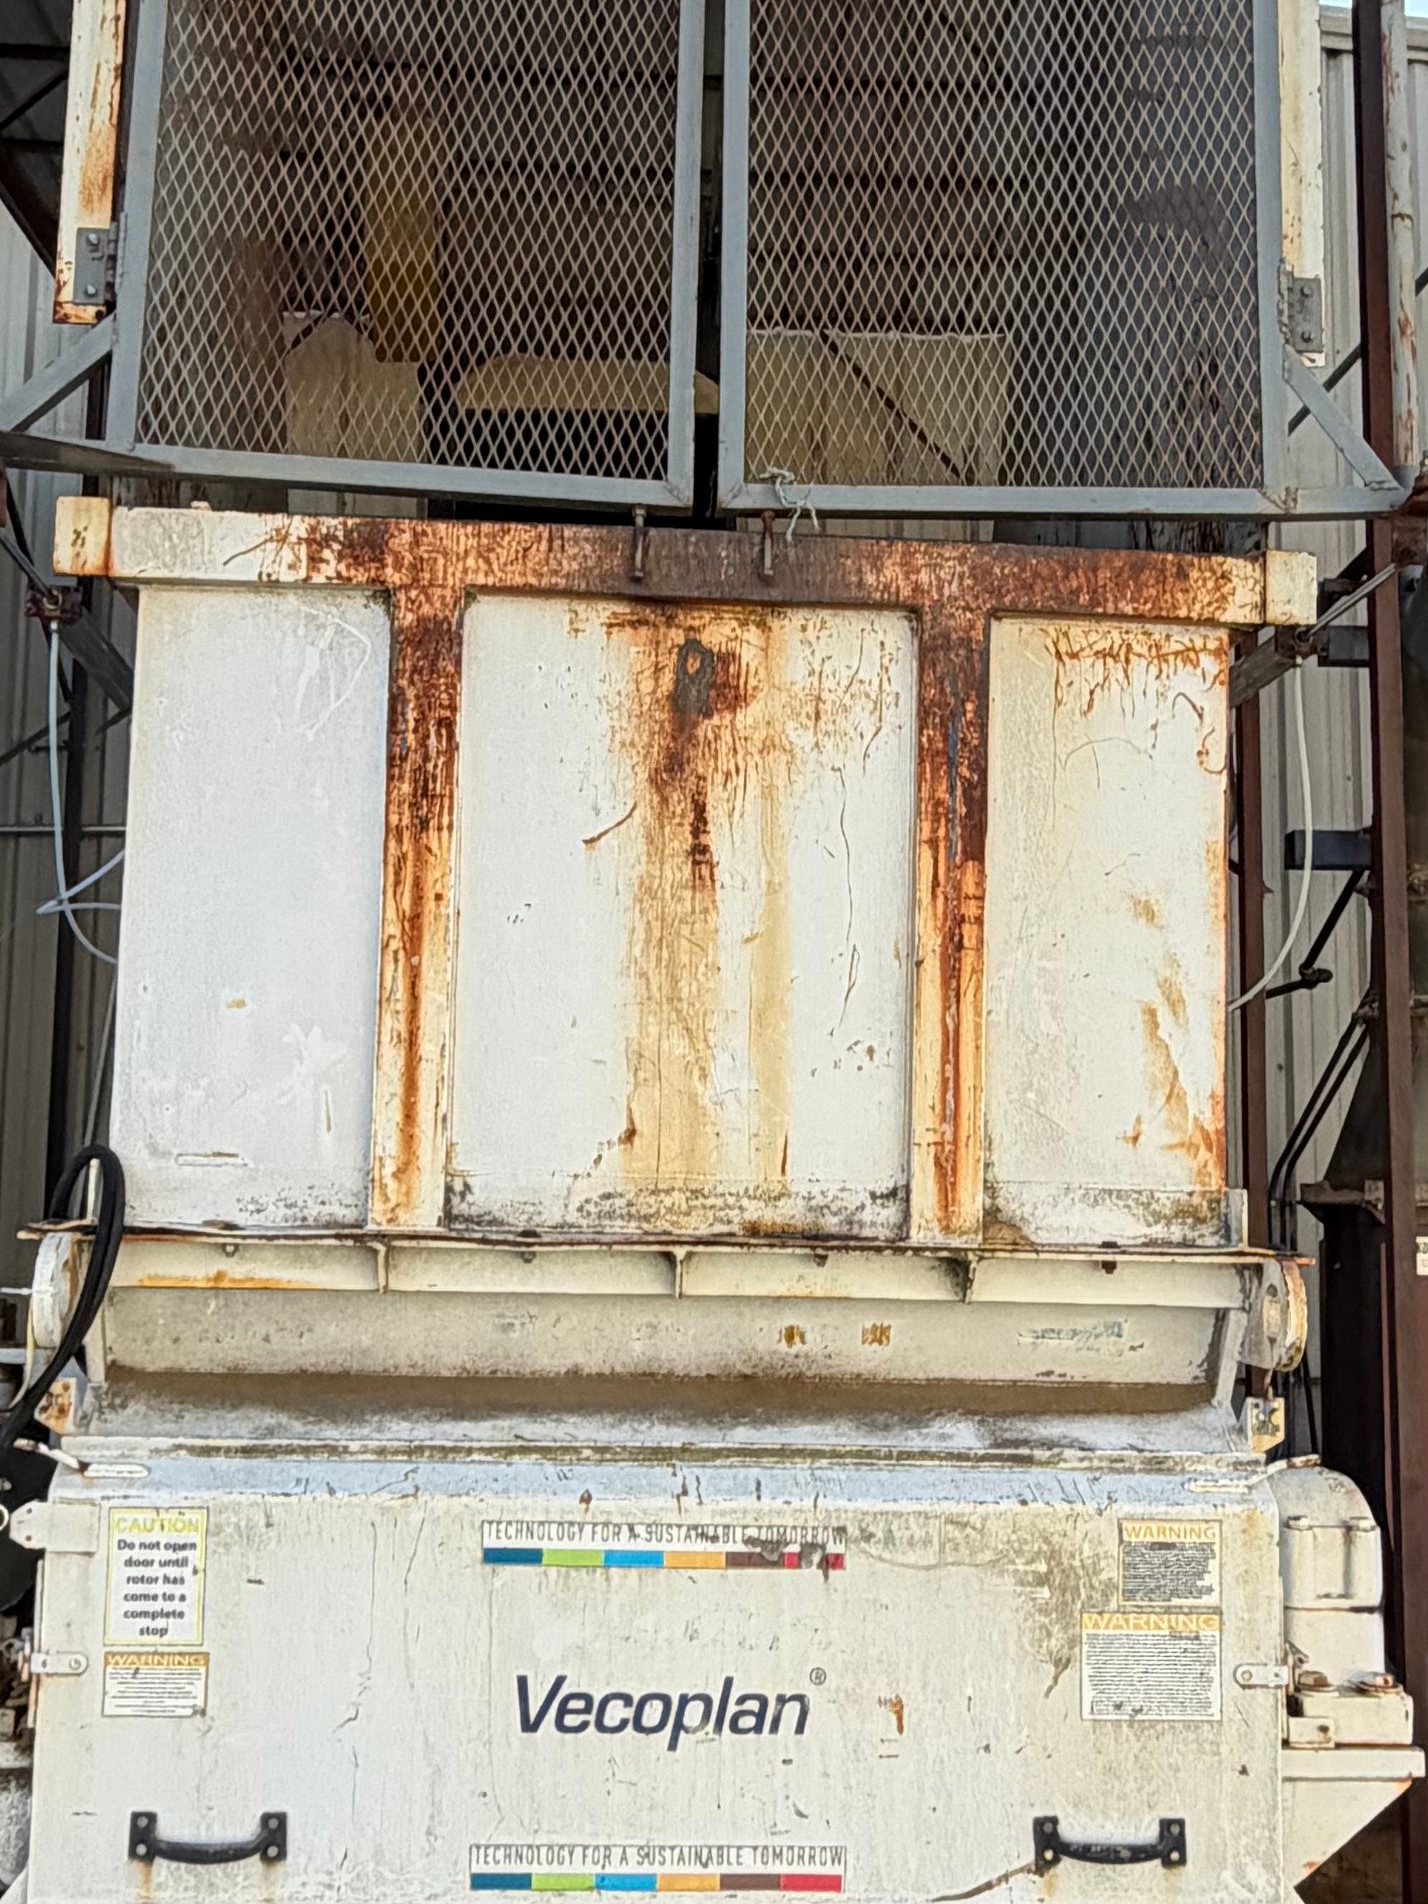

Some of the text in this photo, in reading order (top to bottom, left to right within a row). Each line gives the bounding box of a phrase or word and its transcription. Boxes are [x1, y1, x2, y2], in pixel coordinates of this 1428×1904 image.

[114, 1518, 199, 1532] CAUTION
[487, 1522, 584, 1542] TECHNOLOGY
[592, 1523, 621, 1542] FOR
[644, 1524, 747, 1544] SUSTAINABLE
[757, 1526, 846, 1545] TOMORROW
[1125, 1526, 1216, 1539] WARNING
[117, 1539, 197, 1553] Do not open
[124, 1556, 188, 1567] door until
[126, 1574, 185, 1585] rotor has
[123, 1592, 186, 1602] come to a
[123, 1608, 185, 1621] complete
[1083, 1614, 1219, 1630] WARNING
[139, 1625, 168, 1638] stop
[107, 1655, 206, 1666] WARNING
[516, 1674, 810, 1752] Vecoplan
[474, 1845, 843, 1867] TECHNOLOGY FOR A SUSTAINABLE TOMORROW
